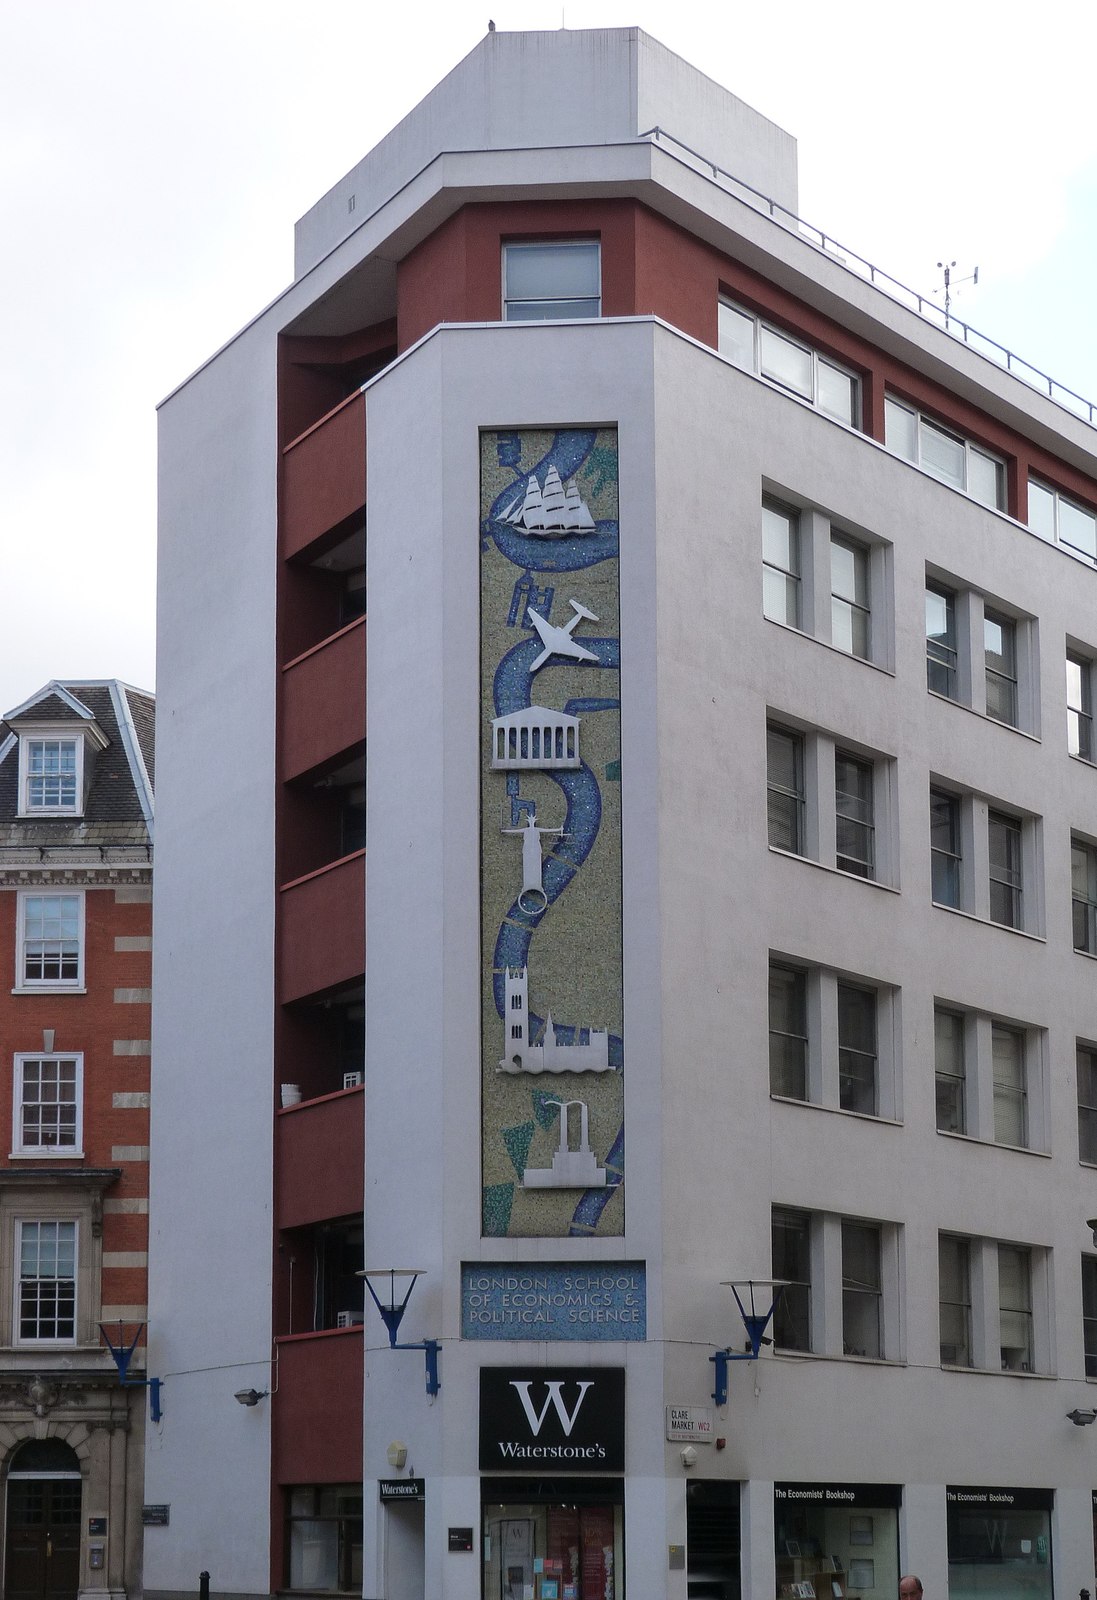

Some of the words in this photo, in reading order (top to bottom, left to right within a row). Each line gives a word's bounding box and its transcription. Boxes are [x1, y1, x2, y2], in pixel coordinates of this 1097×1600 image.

[469, 1278, 548, 1290] LONDON
[564, 1277, 639, 1290] SCHOOL
[469, 1294, 493, 1307] OF
[502, 1293, 612, 1307] ECONOMICS
[625, 1293, 639, 1307] &
[470, 1310, 554, 1323] POLITICAL
[569, 1309, 640, 1323] SCIENCE
[508, 1381, 595, 1437] W
[671, 1410, 688, 1420] CLARE
[671, 1420, 694, 1430] MARKET
[698, 1422, 711, 1431] WC2
[498, 1442, 606, 1458] Waterstone's
[381, 1483, 418, 1495] Waterstone's
[775, 1489, 787, 1499] The
[787, 1489, 824, 1499] Economists'
[825, 1490, 855, 1501] Bookshop
[947, 1492, 956, 1501] The
[957, 1492, 988, 1501] Economists'
[990, 1493, 1015, 1504] Bookshop
